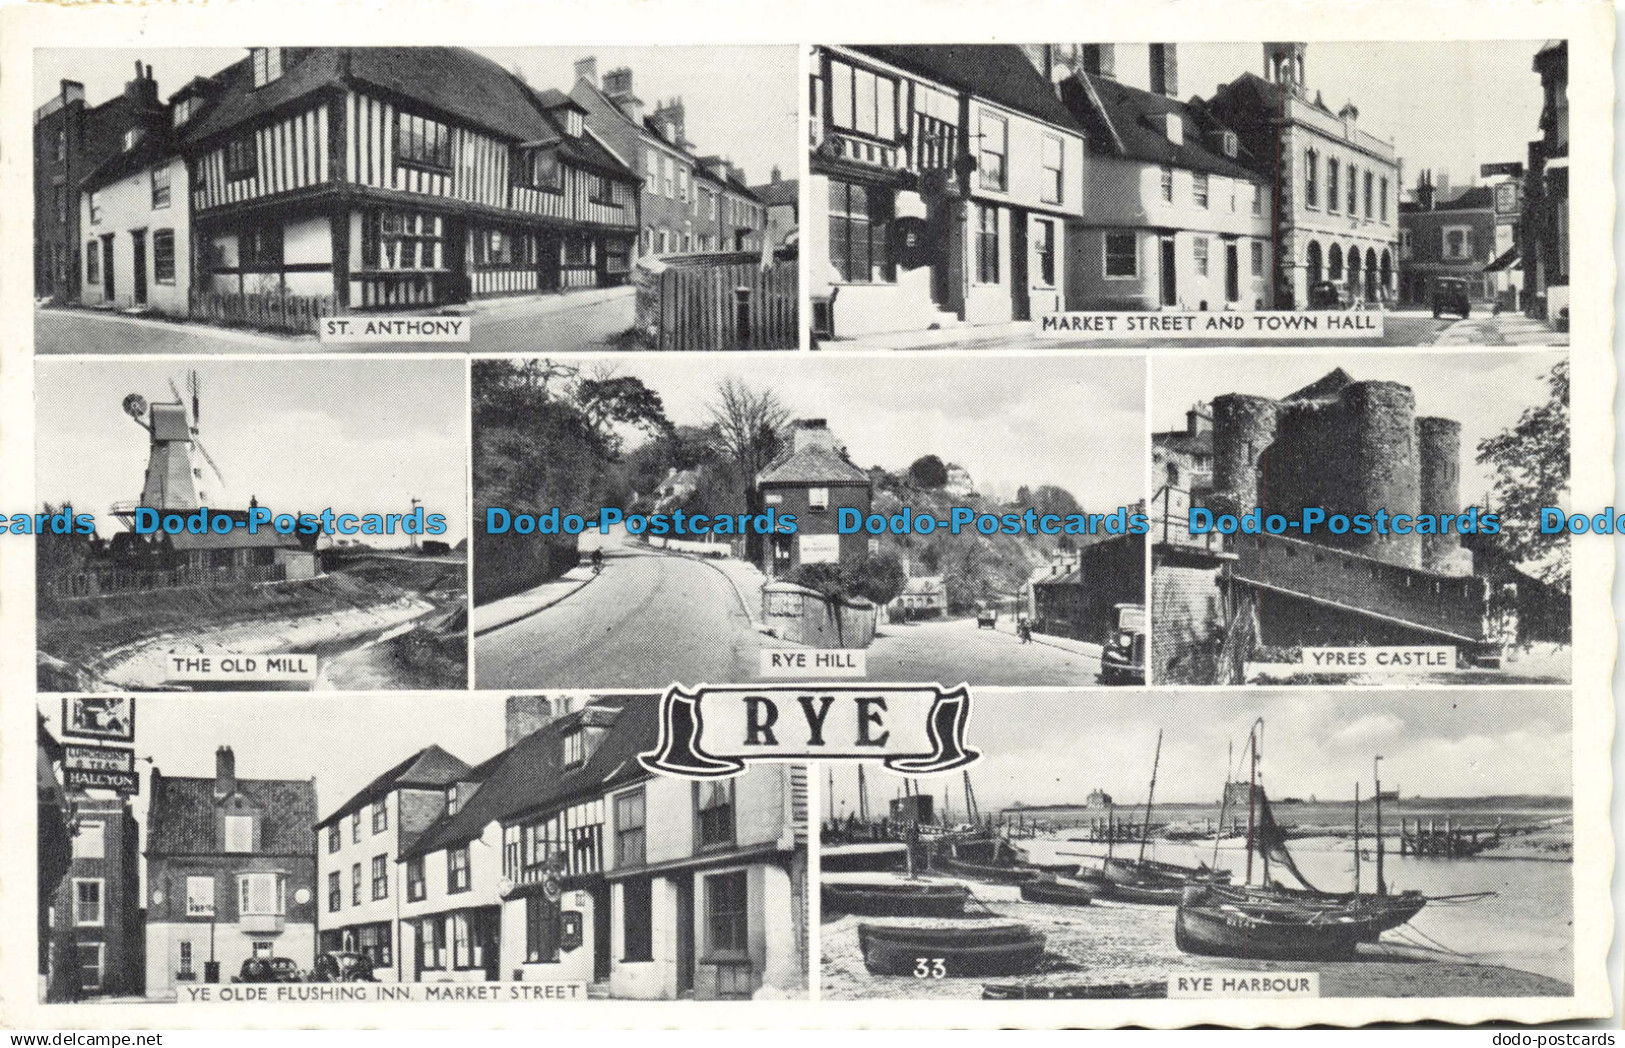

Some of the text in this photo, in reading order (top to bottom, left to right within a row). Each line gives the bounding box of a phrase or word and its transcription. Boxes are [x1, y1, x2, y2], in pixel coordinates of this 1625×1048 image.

[321, 321, 462, 335] ST. ANTHONY
[1042, 315, 1376, 331] MARKET STREET AND TOWN HALL
[173, 658, 309, 673] THE OLD MILL
[772, 653, 855, 668] RYE HILL
[1312, 652, 1447, 666] YPRES CASTLE
[742, 695, 890, 748] RYE
[69, 772, 134, 786] HALCYON
[913, 957, 946, 979] 33
[1178, 976, 1311, 992] RYE HARBOUR
[187, 986, 212, 1001] YE
[218, 986, 268, 1001] OLDE
[276, 986, 367, 1001] FLUSHING
[425, 985, 501, 1000] MARKET
[510, 984, 581, 1000] STREET
